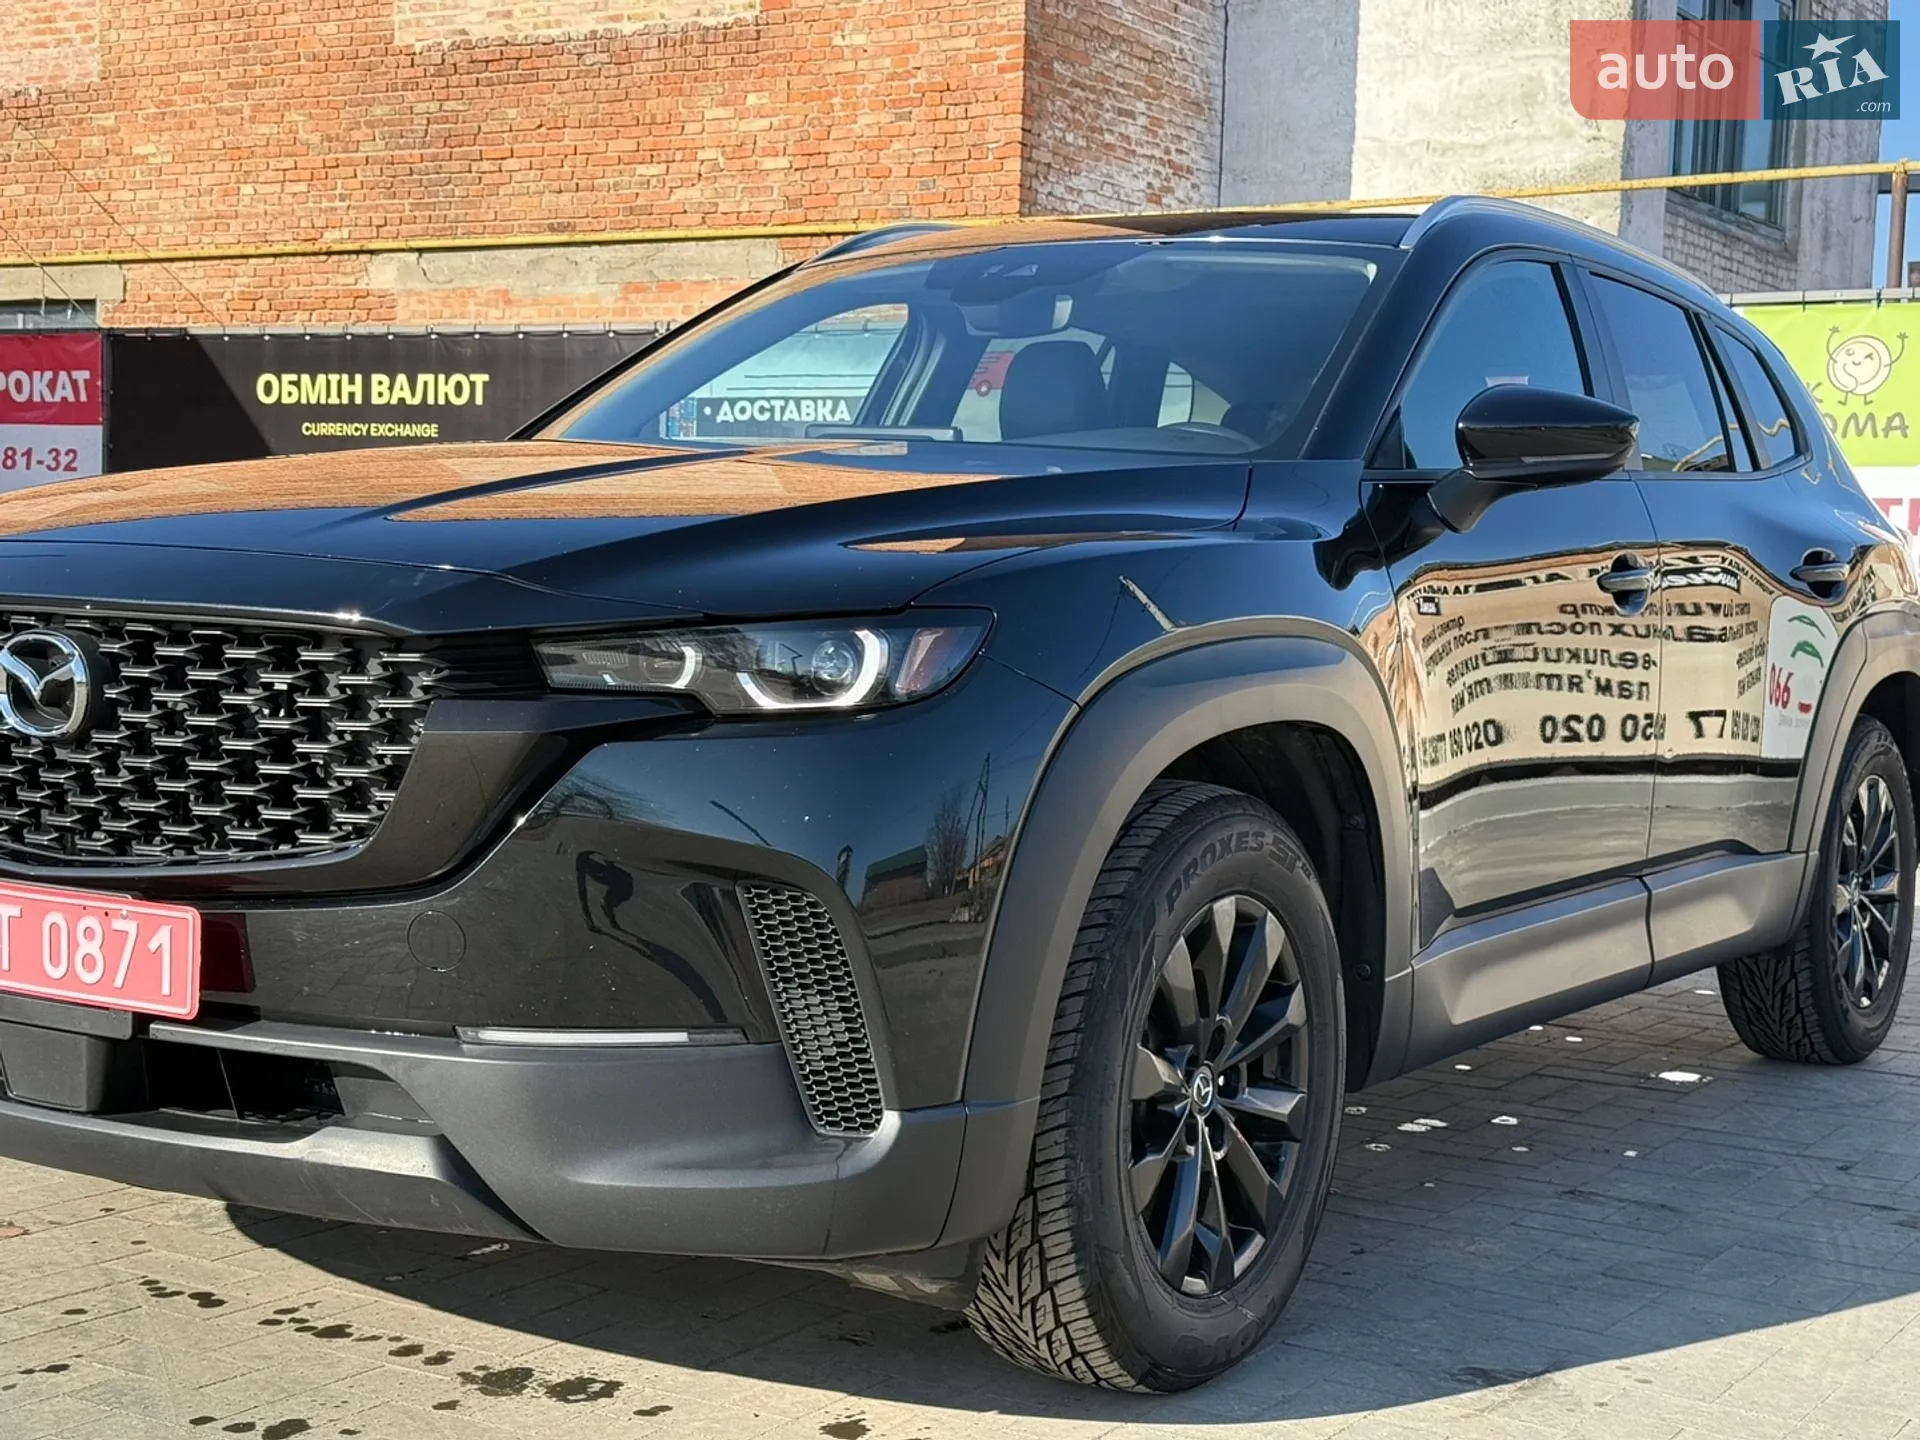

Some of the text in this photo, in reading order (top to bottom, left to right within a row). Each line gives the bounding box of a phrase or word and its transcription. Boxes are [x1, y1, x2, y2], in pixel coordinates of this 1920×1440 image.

[256, 373, 490, 406] ОБМІН ВАЛЮТ
[716, 399, 851, 423] ДОСТАВКА
[301, 422, 440, 438] CURRENCY EXCHANGE
[1, 446, 79, 473] 81-32
[1166, 831, 1266, 917] PROXES
[41, 911, 174, 996] 0871
